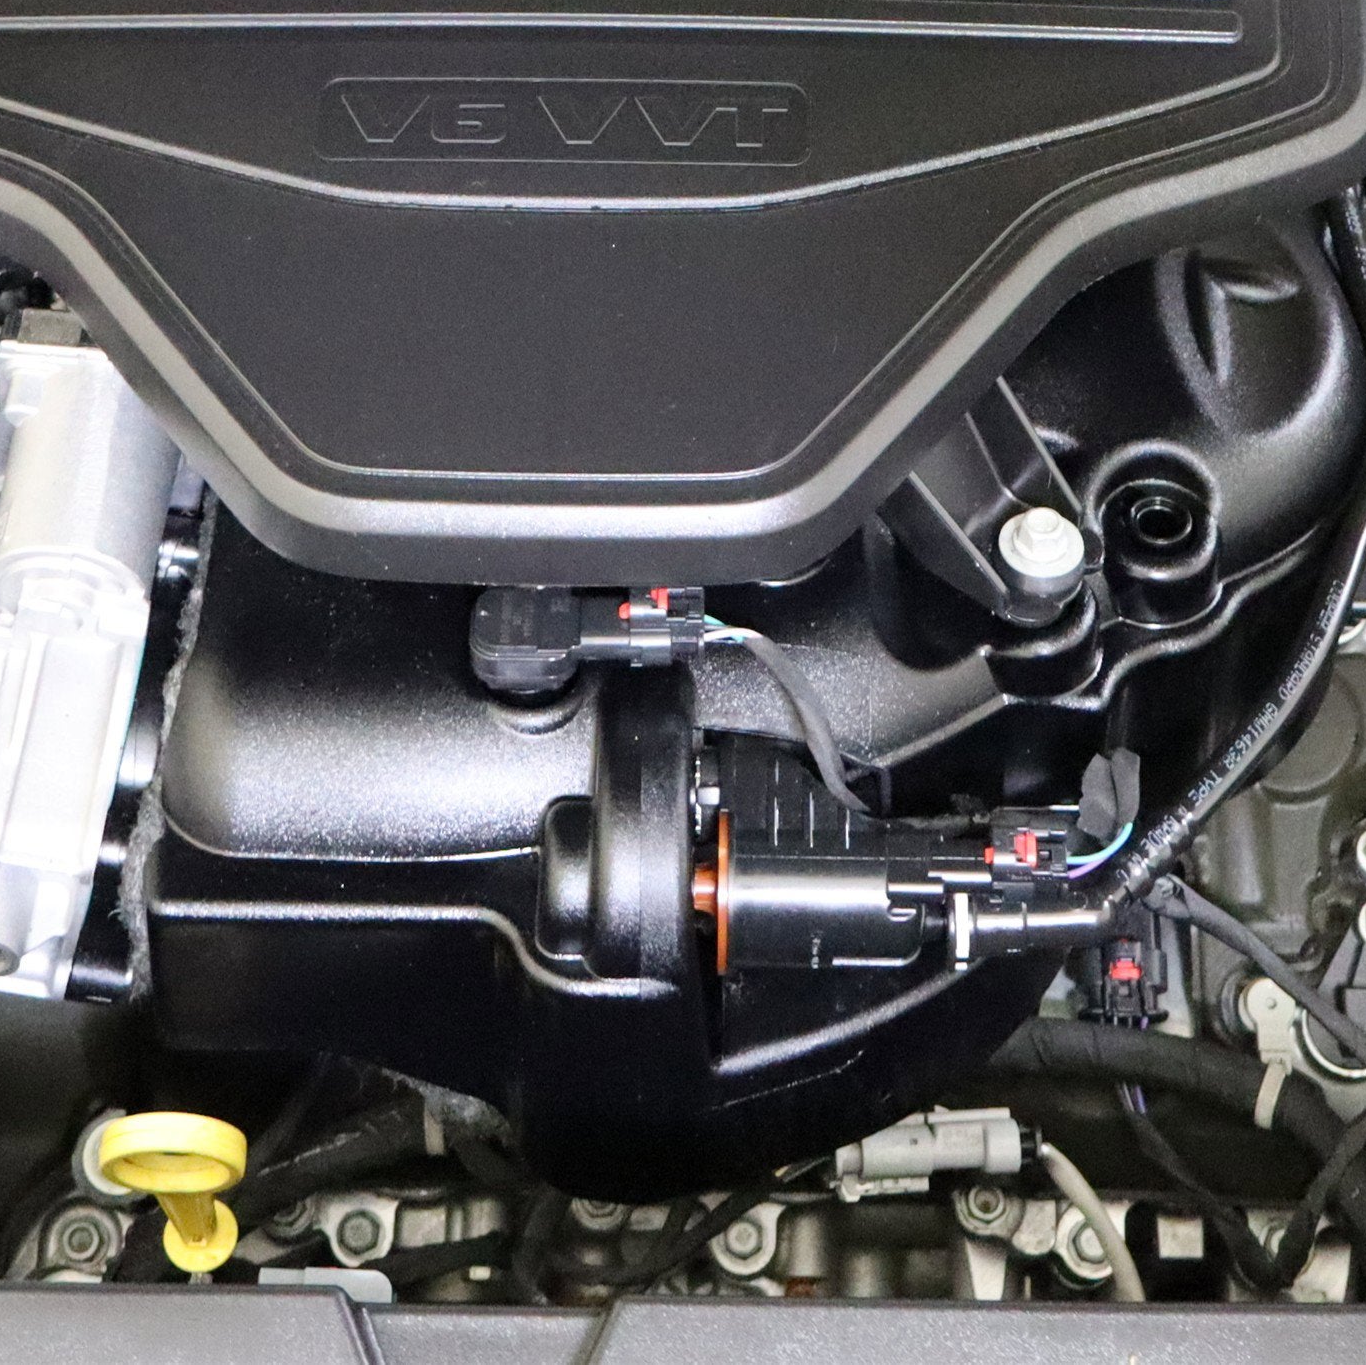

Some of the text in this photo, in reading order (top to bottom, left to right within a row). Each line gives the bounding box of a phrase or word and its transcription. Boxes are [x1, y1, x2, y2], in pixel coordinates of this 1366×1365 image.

[341, 94, 790, 148] V6 VVT
[1188, 771, 1222, 805] TYPE
